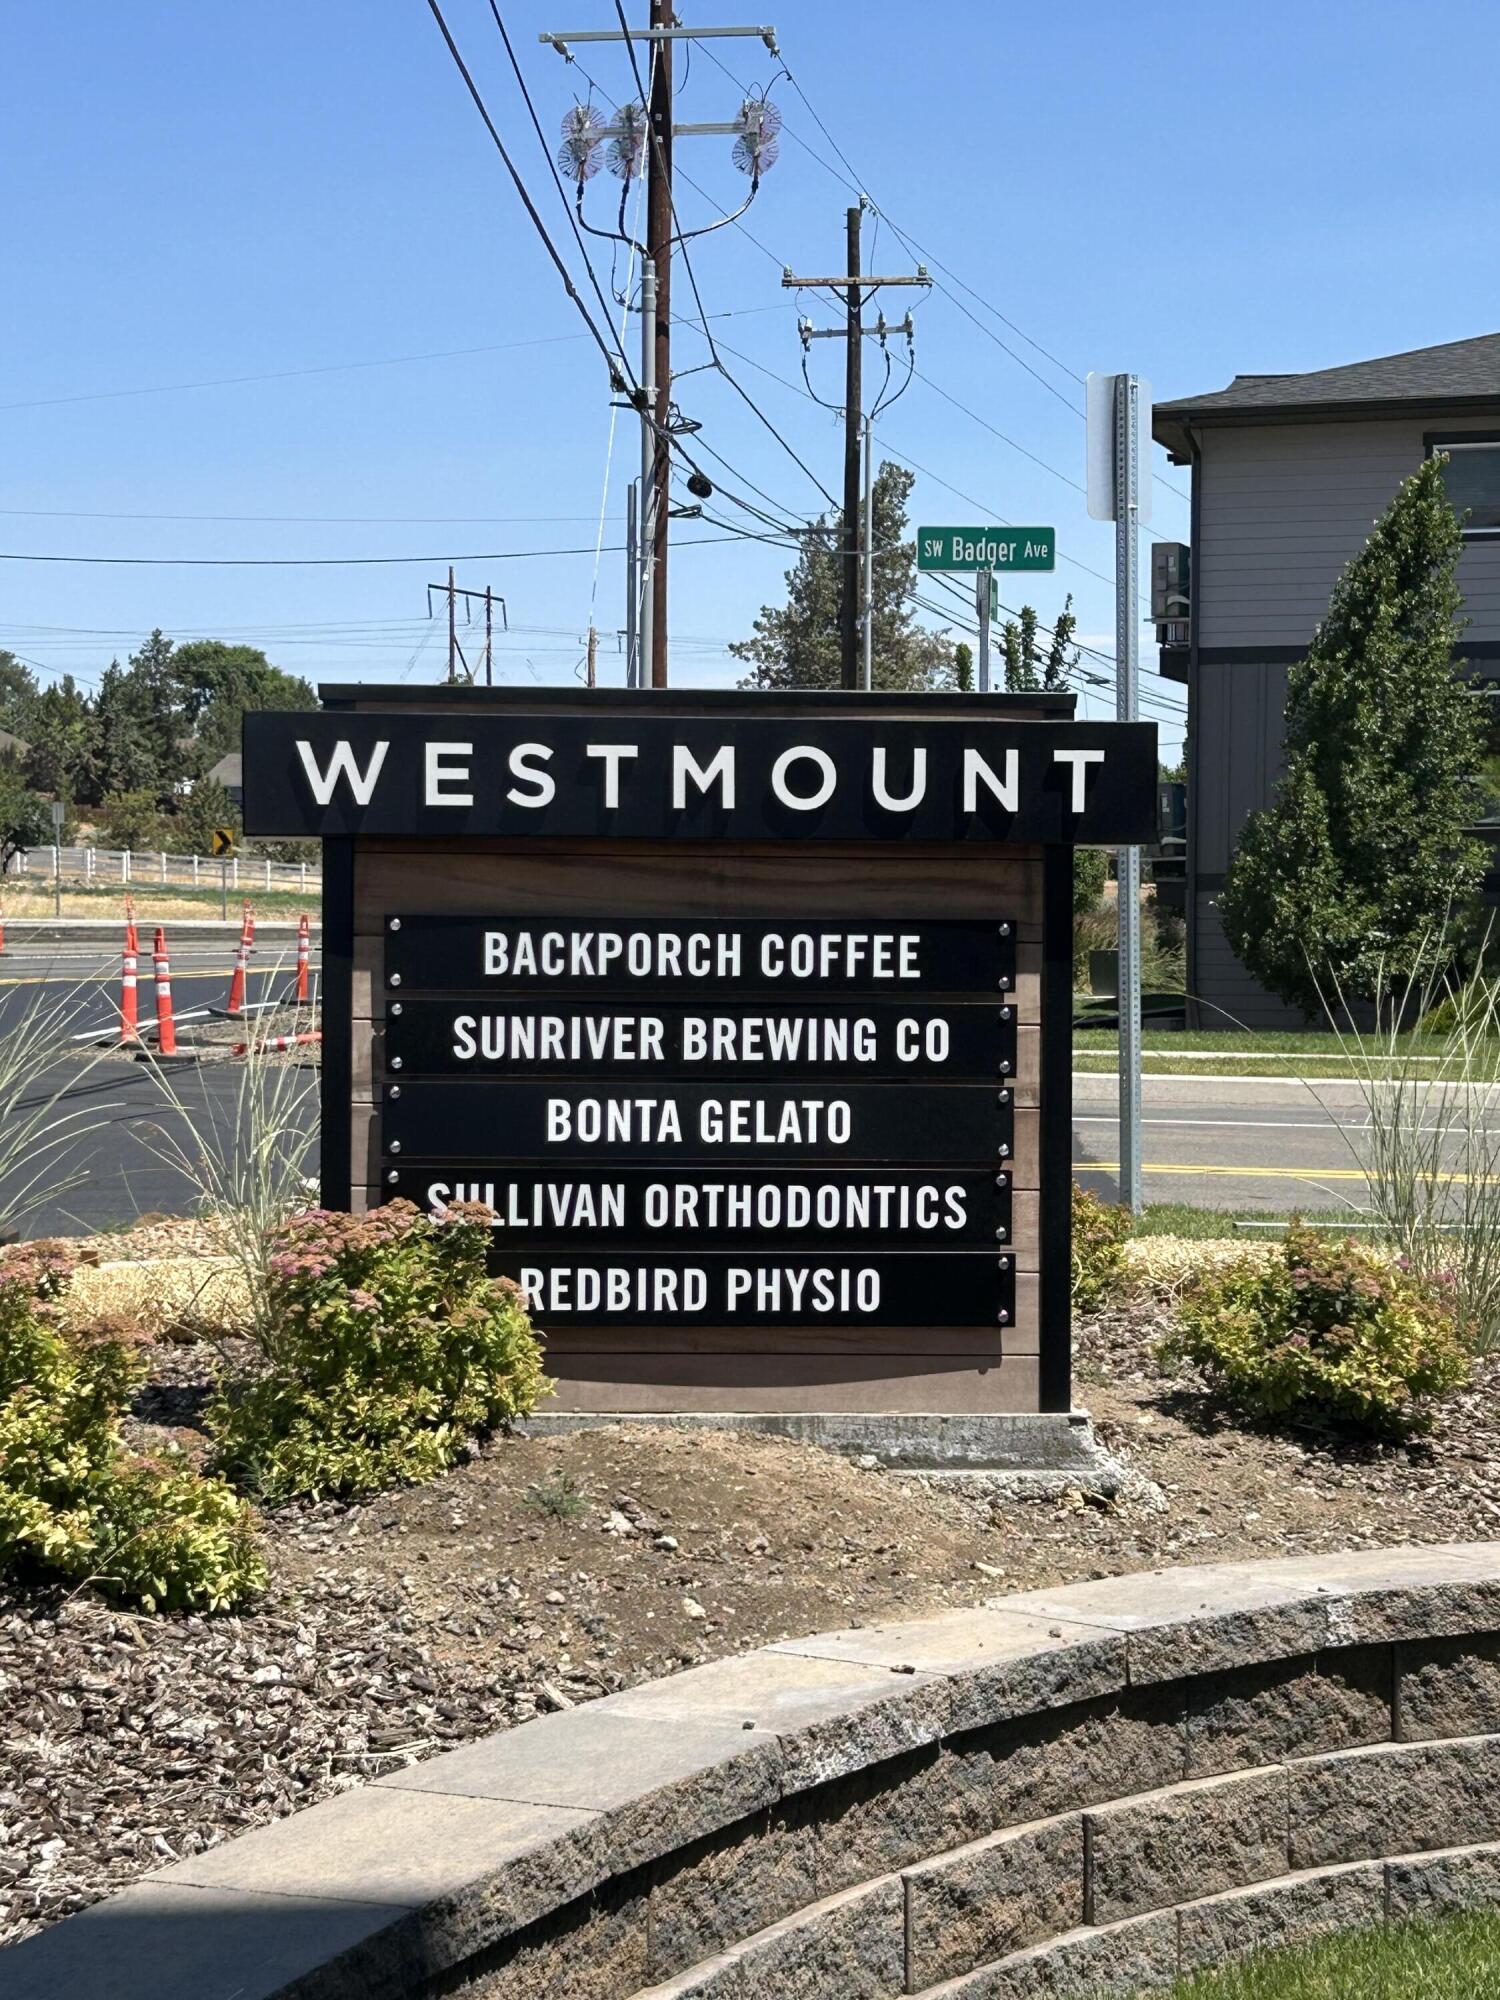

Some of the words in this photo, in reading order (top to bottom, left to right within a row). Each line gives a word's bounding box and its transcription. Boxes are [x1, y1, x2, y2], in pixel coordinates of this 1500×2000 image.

[924, 540, 943, 557] SW
[952, 536, 1017, 566] Badger
[1024, 540, 1048, 558] Ave
[295, 740, 1106, 813] WESTMOUNT
[484, 931, 741, 977] BACKPORCH
[760, 933, 921, 978] COFFEE
[452, 1015, 665, 1060] SUNRIVER
[683, 1017, 877, 1062] BREWING
[896, 1018, 950, 1062] CO
[546, 1099, 683, 1143] BONTA
[700, 1100, 851, 1144] GELATO
[645, 1183, 967, 1229] ORTHODONTICS
[520, 1267, 707, 1312] REDBIRD
[727, 1268, 881, 1312] PHYSIO
